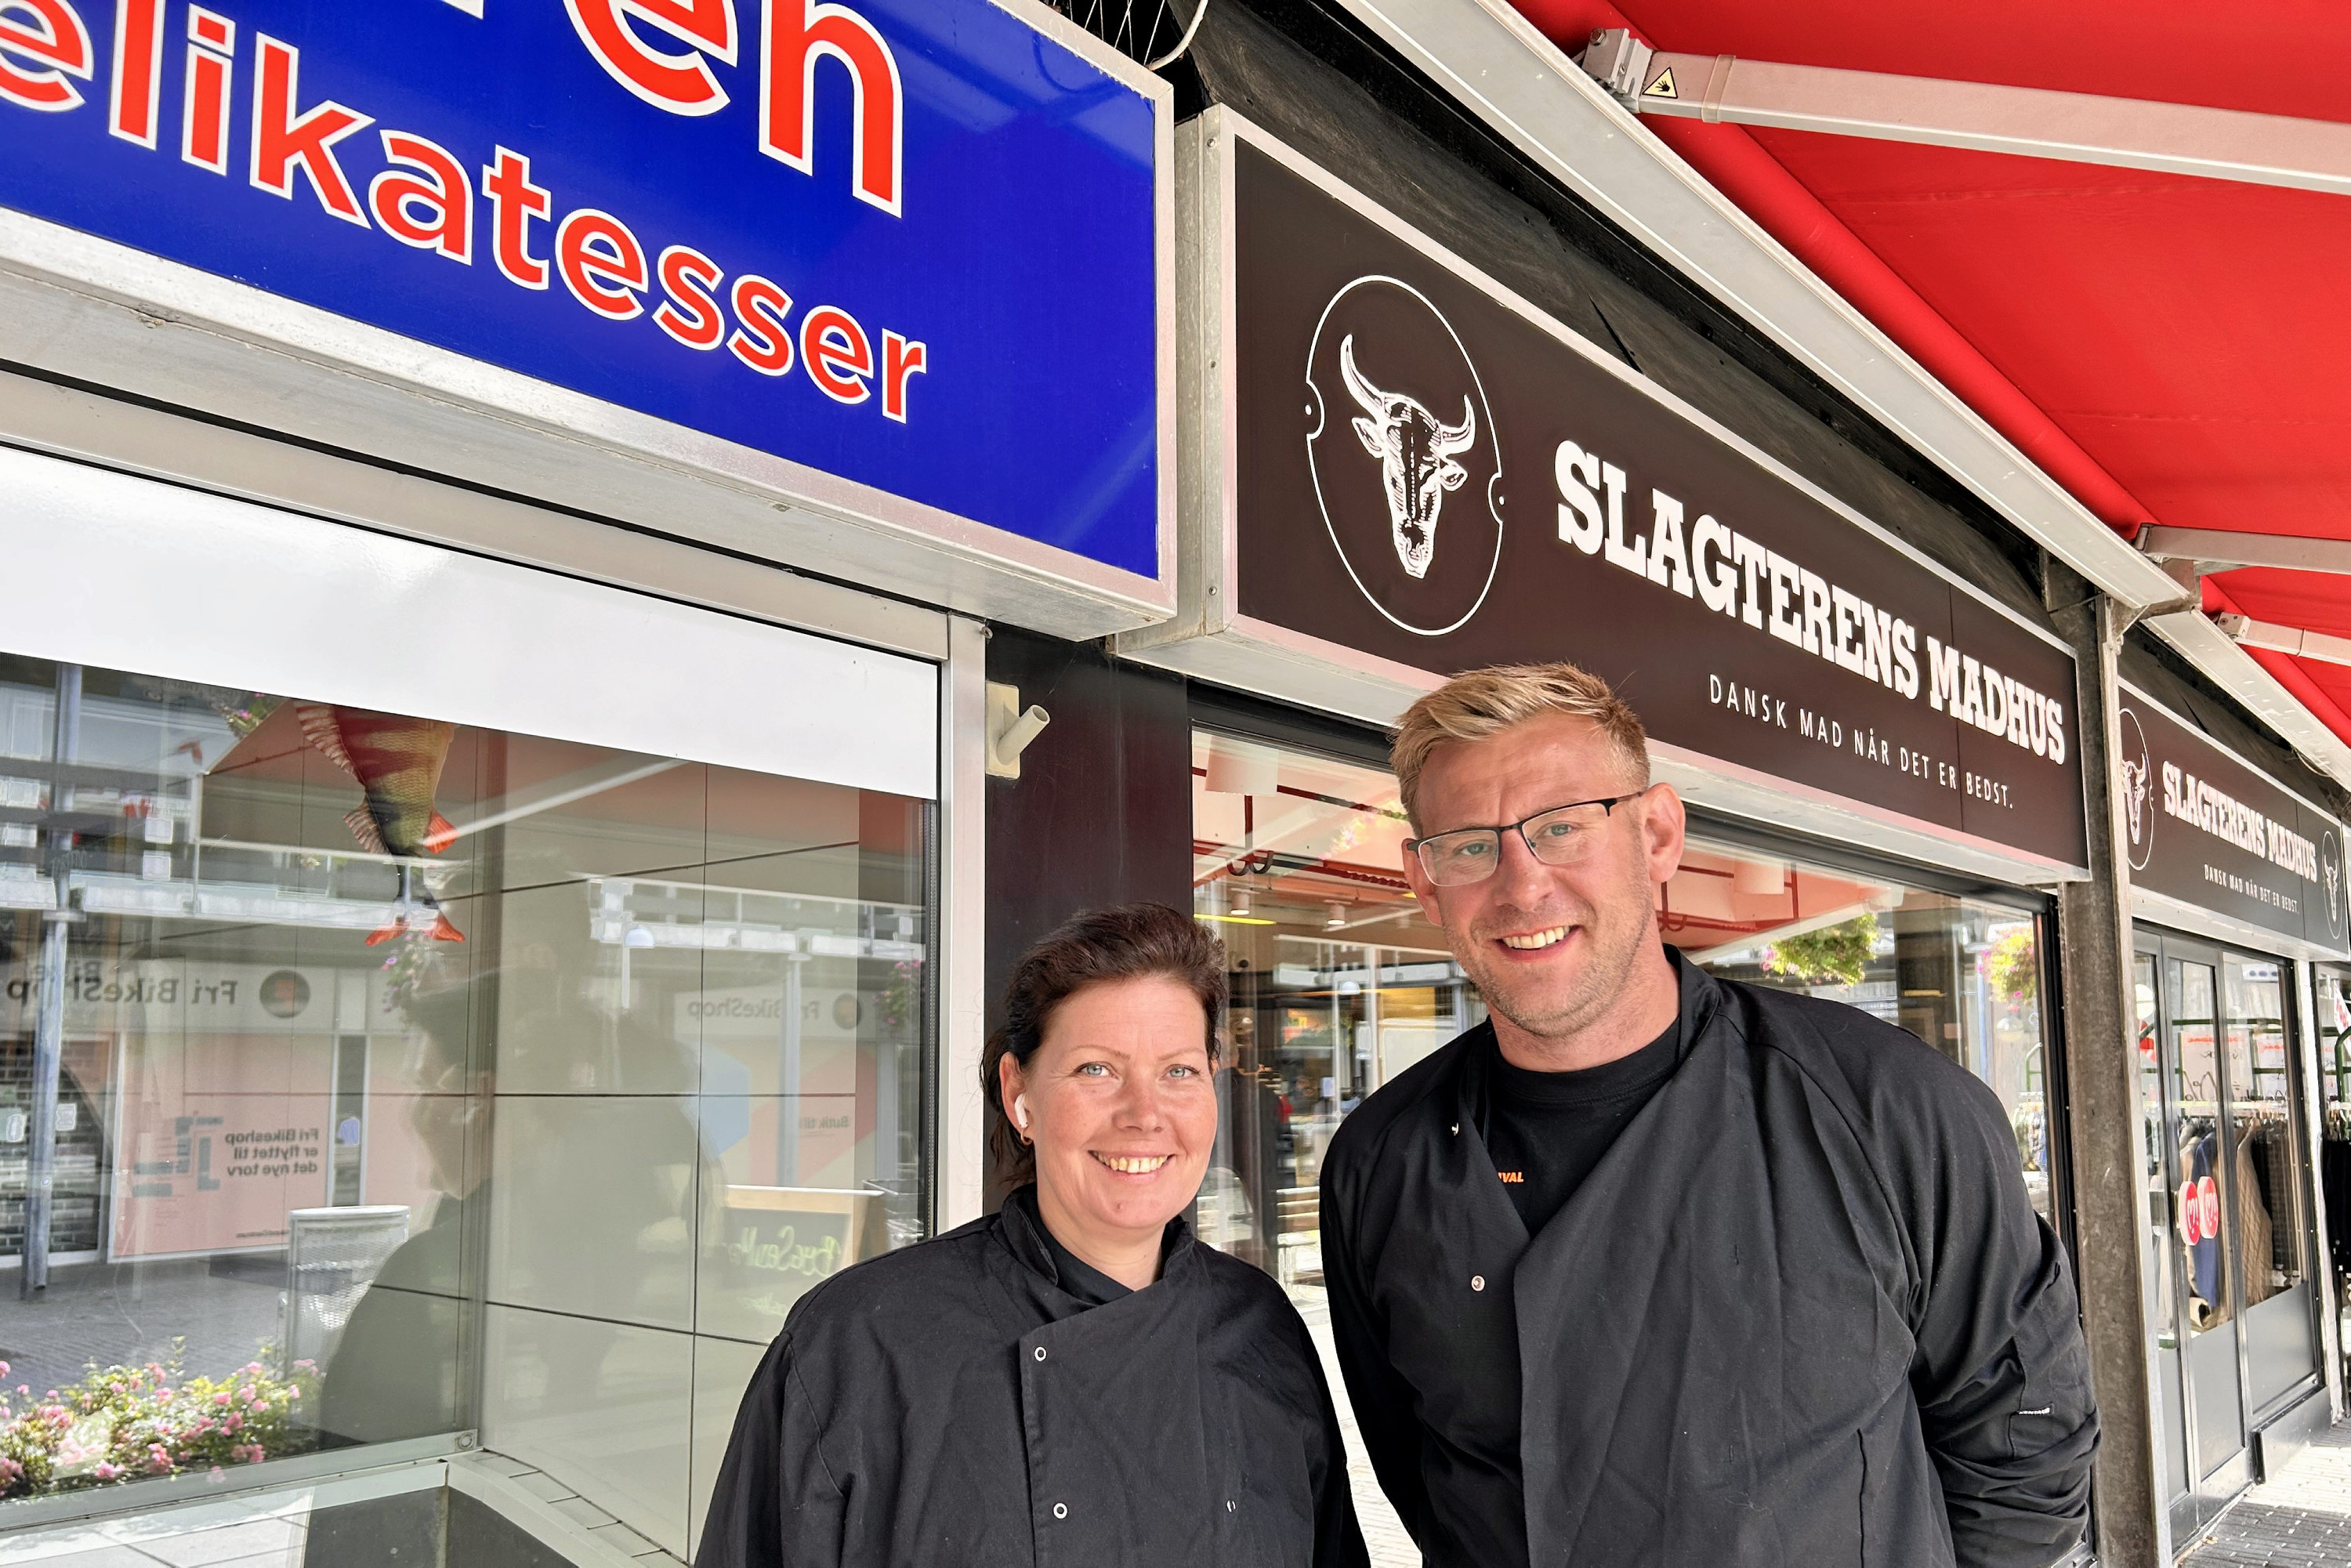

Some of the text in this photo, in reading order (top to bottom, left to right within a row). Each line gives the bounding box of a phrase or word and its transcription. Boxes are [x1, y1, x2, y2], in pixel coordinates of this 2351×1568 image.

[440, 0, 904, 217] en
[0, 0, 928, 424] elikatesser
[1554, 440, 2066, 766] SLAGTERENS MADHUS
[1709, 674, 2014, 809] DANSK MAD NÅR DET ER BEDST.
[2162, 760, 2317, 884] SLAGTERENS MADHUS
[2204, 864, 2227, 887] DANSK
[2229, 874, 2244, 893] MAD
[2259, 886, 2271, 904] DET
[2273, 892, 2280, 907] ER
